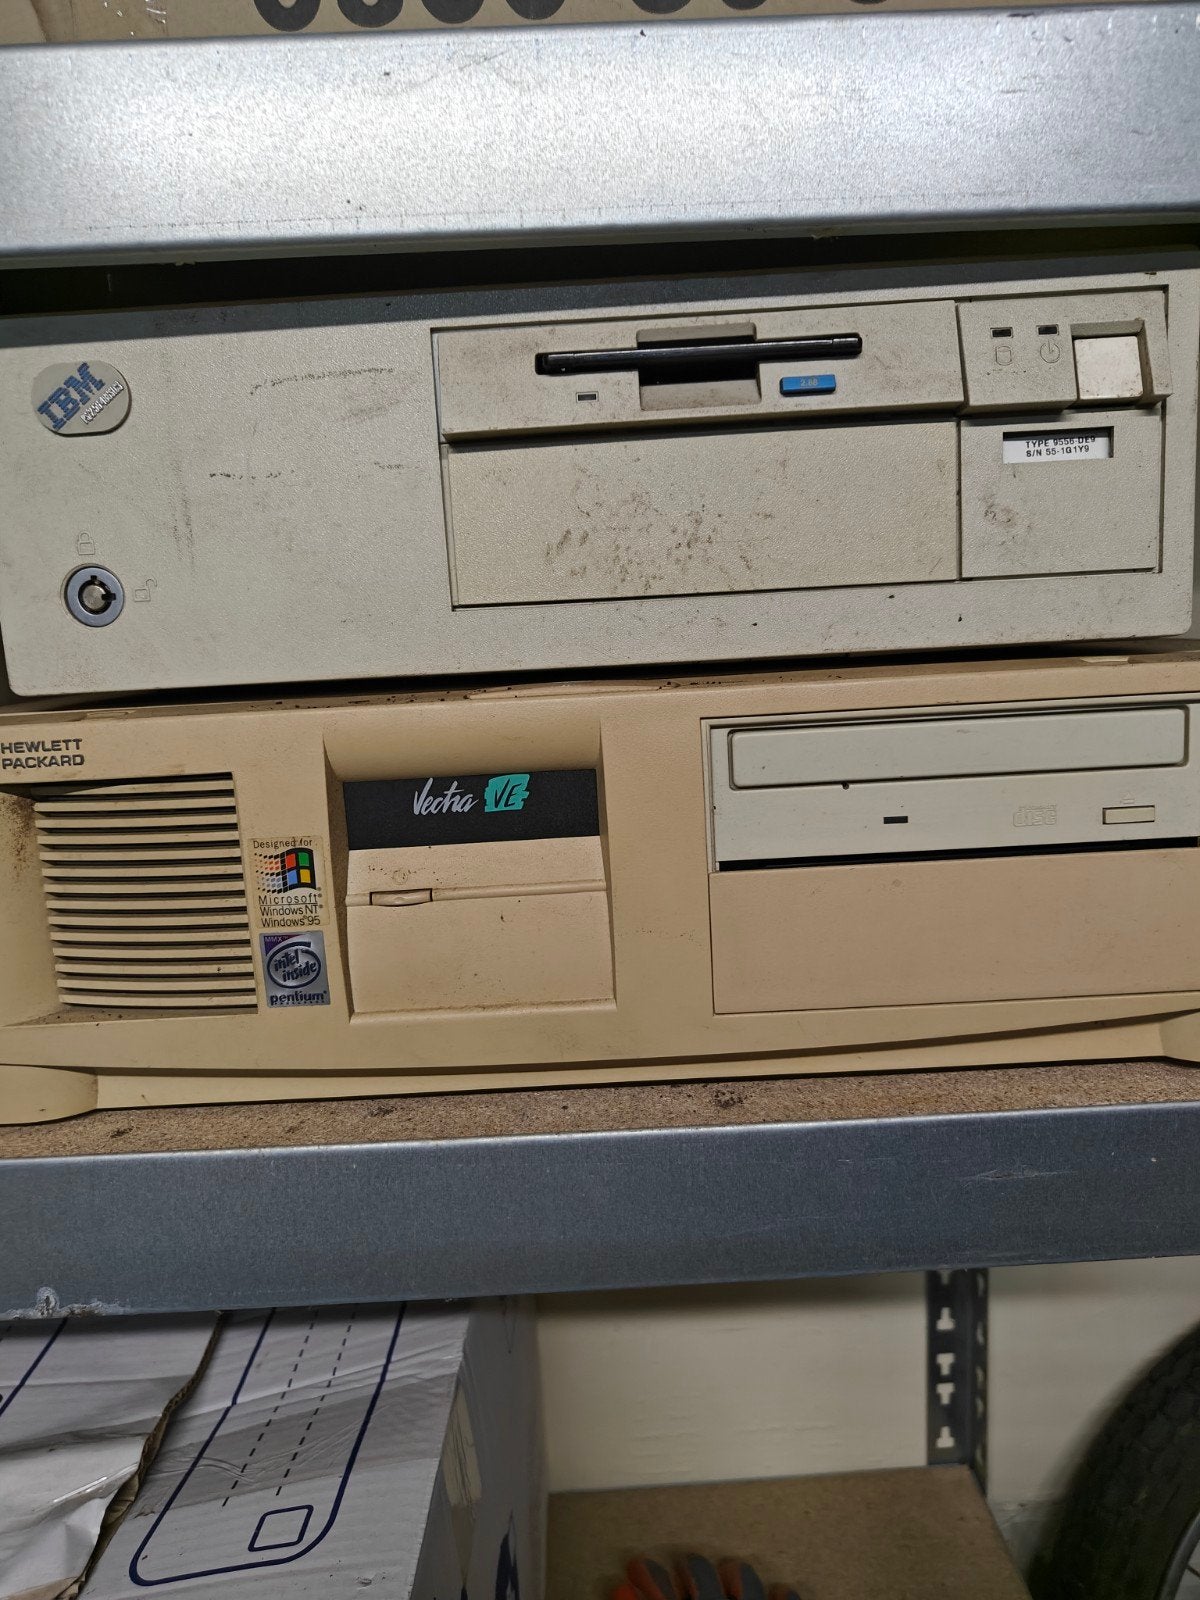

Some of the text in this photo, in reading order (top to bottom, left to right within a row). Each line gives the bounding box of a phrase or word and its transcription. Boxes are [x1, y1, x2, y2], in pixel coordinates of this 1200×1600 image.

[37, 362, 105, 431] IBM
[1025, 437, 1050, 449] TYPE
[1026, 448, 1042, 458] S/N
[1, 738, 82, 754] HEWLETT
[2, 754, 85, 769] PACKARD
[413, 777, 523, 815] Vectra VE
[253, 837, 313, 850] Designed for
[258, 893, 318, 905] Microsoft
[260, 904, 318, 916] Windows NT
[307, 915, 321, 926] 95
[273, 949, 300, 972] intel
[282, 960, 317, 982] inside
[270, 991, 324, 1006] pentium
